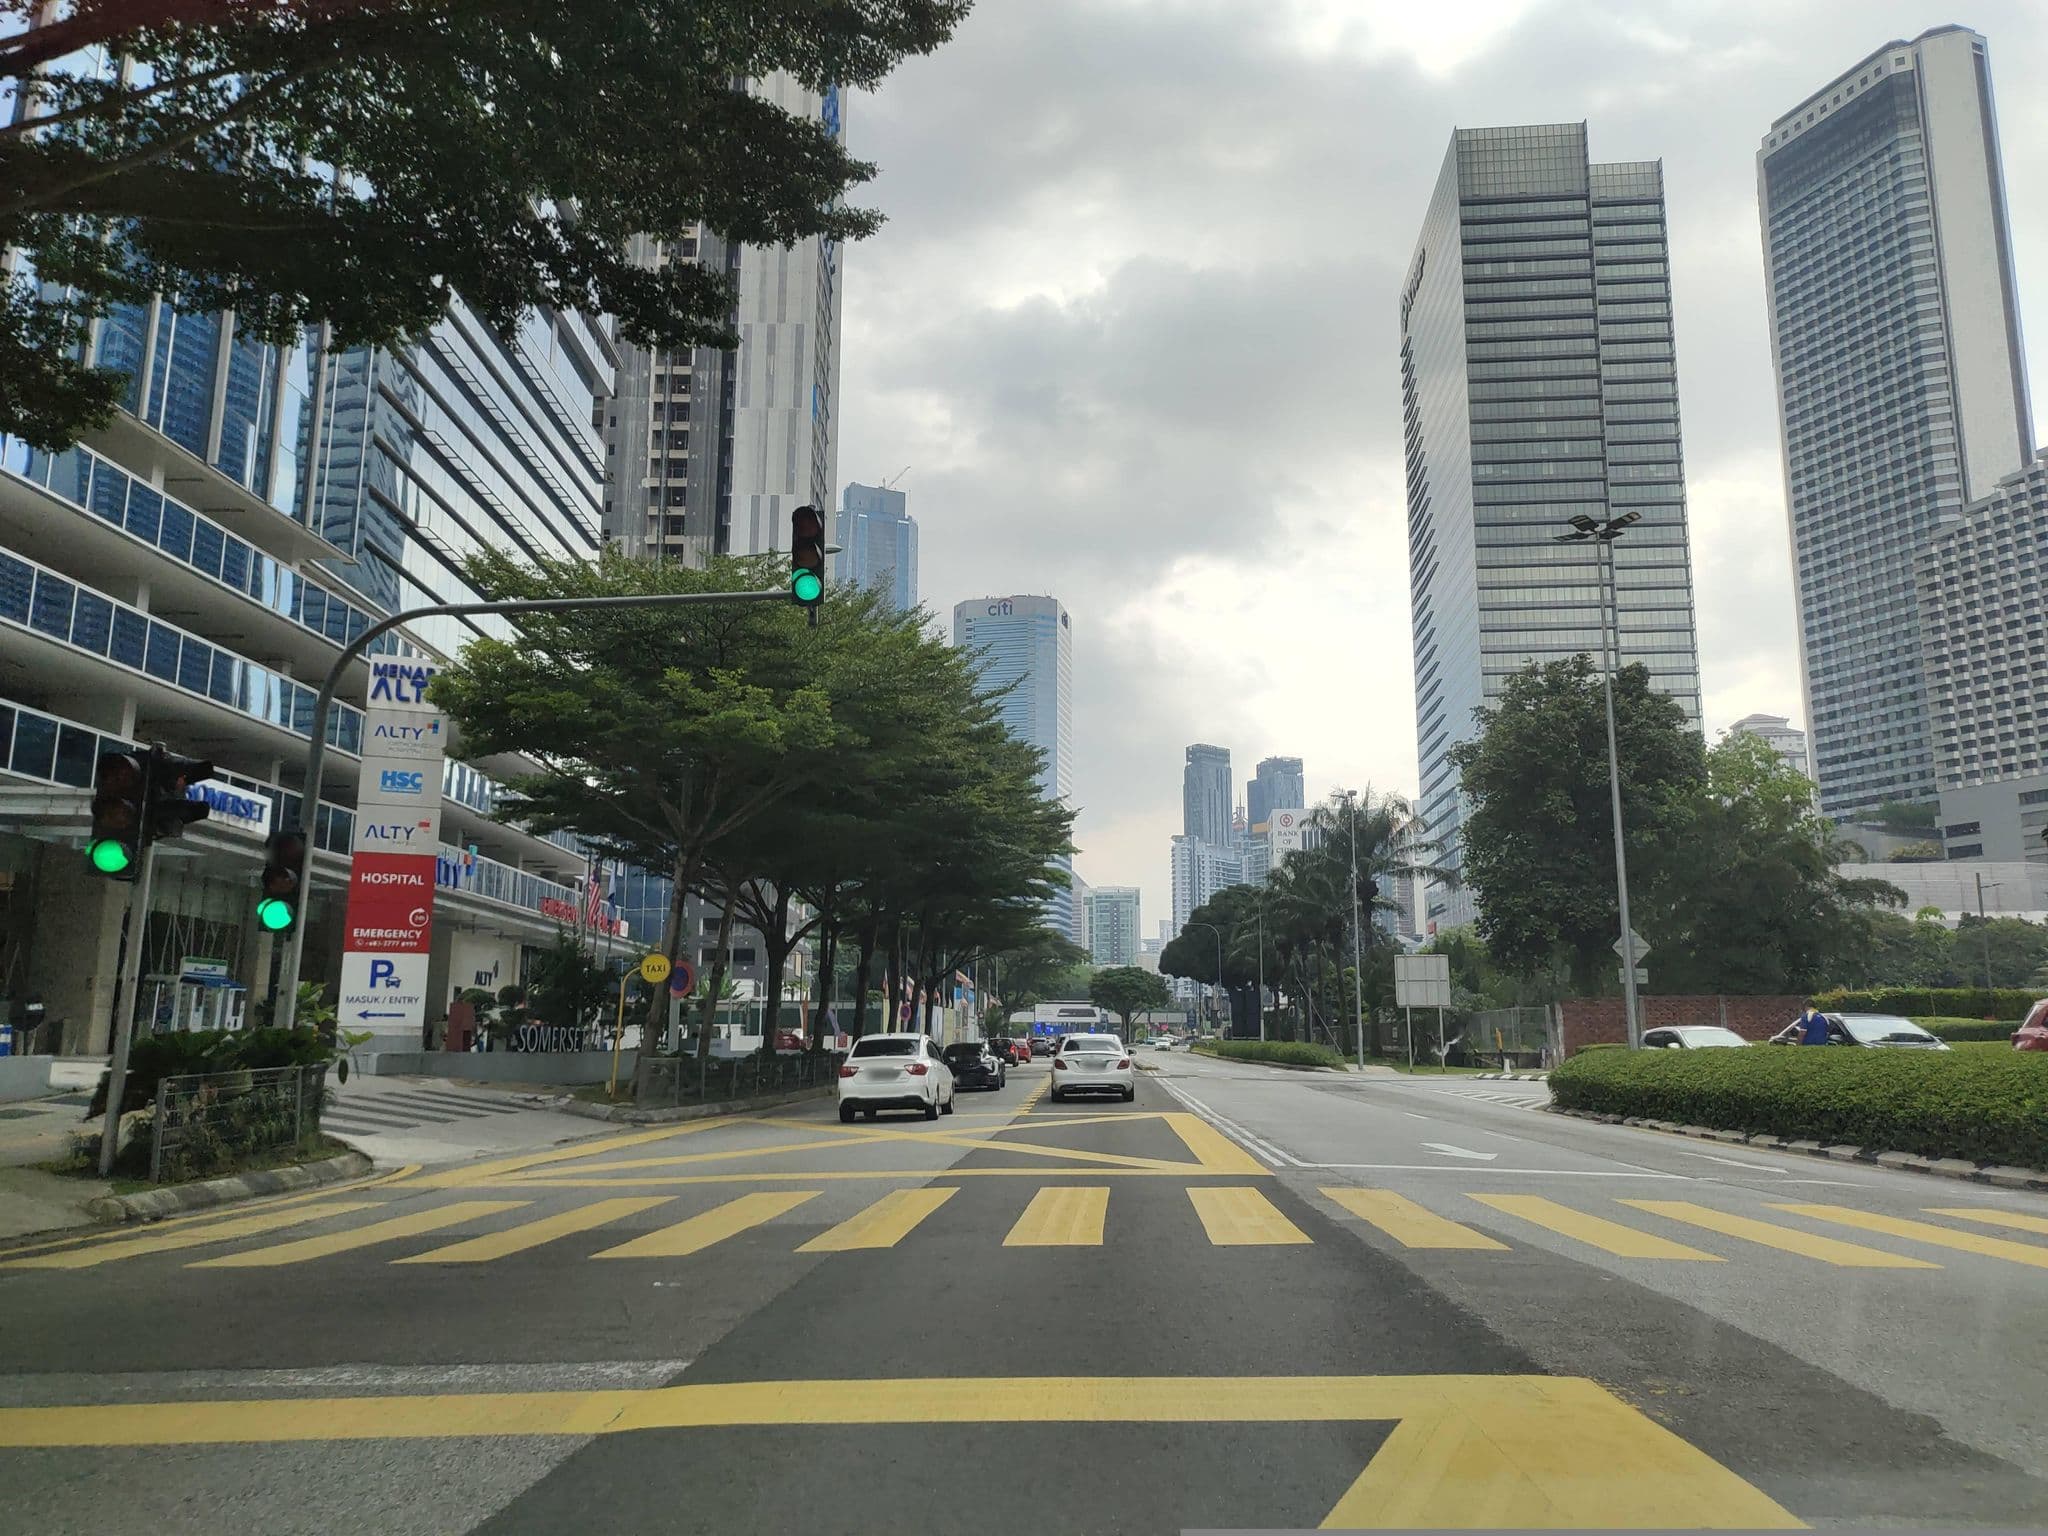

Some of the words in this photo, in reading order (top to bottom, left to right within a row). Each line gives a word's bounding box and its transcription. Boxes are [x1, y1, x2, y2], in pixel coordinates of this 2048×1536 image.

[988, 600, 1013, 616] citi
[374, 725, 424, 740] ALTY
[381, 769, 422, 789] HSC
[365, 824, 415, 840] ALTY
[361, 872, 424, 886] HOSPITAL
[353, 928, 422, 939] EMERGENCY
[369, 959, 394, 989] P
[646, 964, 666, 973] TAXI
[345, 995, 380, 1004] MASUK
[389, 995, 420, 1005] ENTRY
[517, 1024, 587, 1053] SOMERSET
